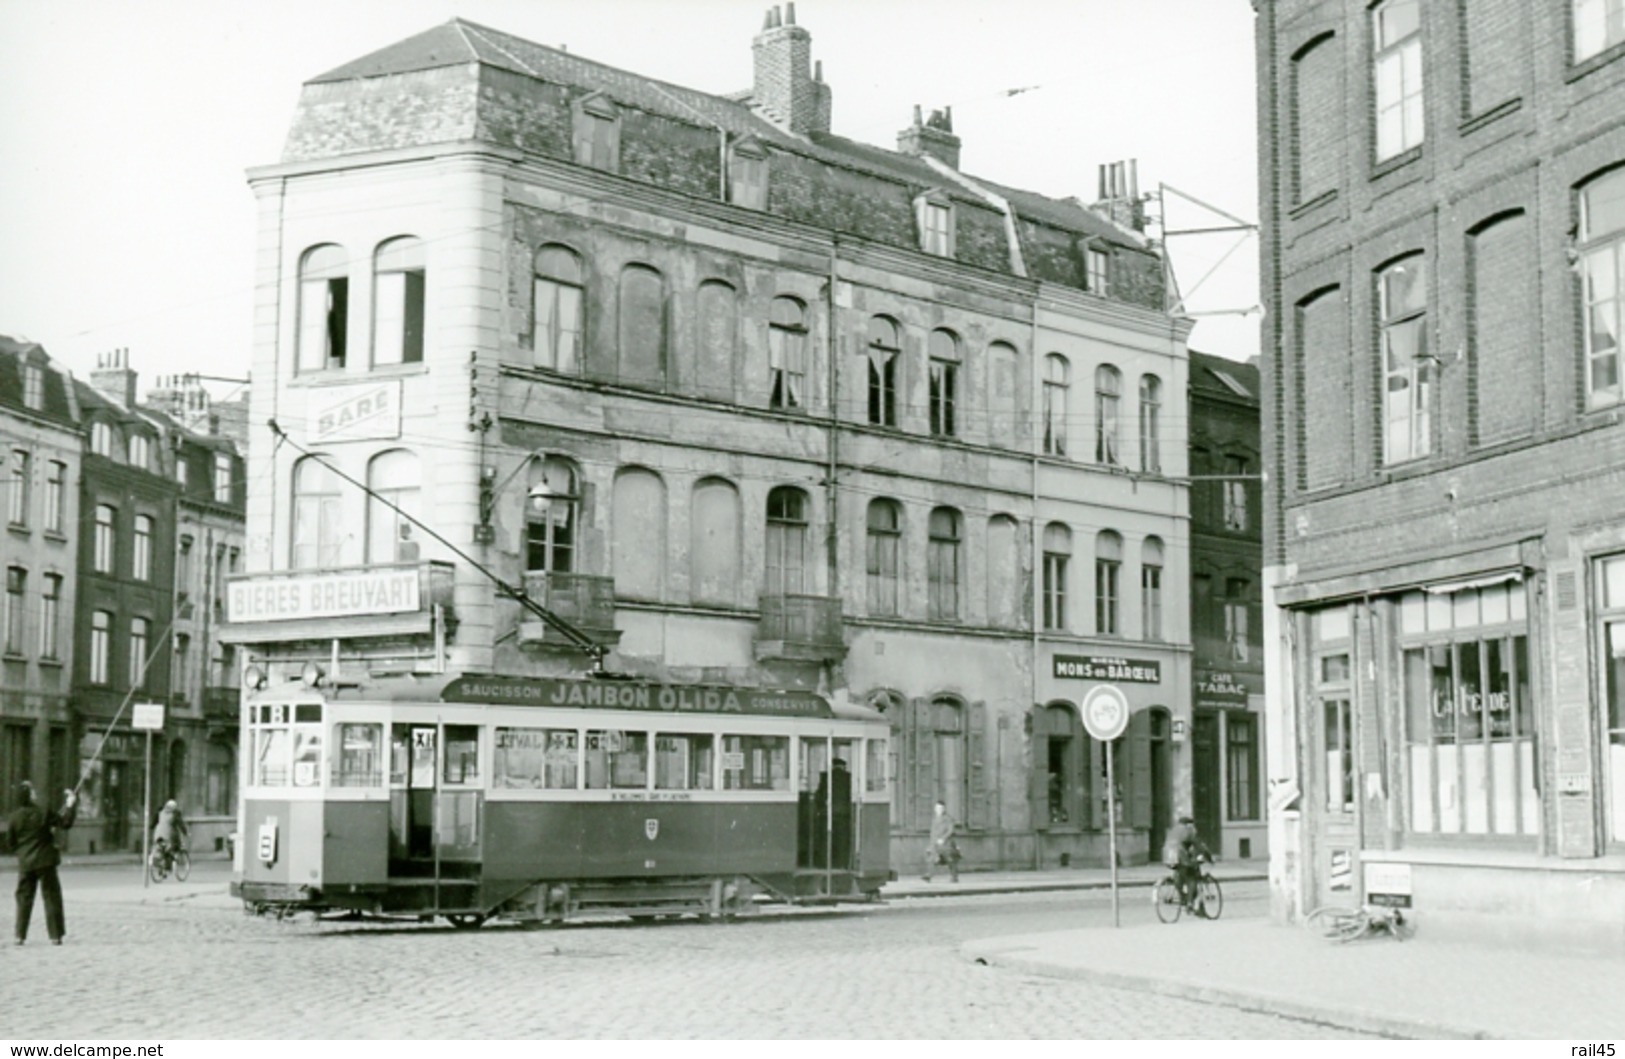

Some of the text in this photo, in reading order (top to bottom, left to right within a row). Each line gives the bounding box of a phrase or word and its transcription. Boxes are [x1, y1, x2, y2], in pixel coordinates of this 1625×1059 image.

[234, 576, 416, 616] BIERES BREUVART
[1056, 662, 1092, 677] MONS
[460, 683, 542, 699] SAUCISSON
[551, 682, 650, 708] JAMBON
[661, 690, 741, 712] OLIDA
[1198, 682, 1246, 695] TABAC
